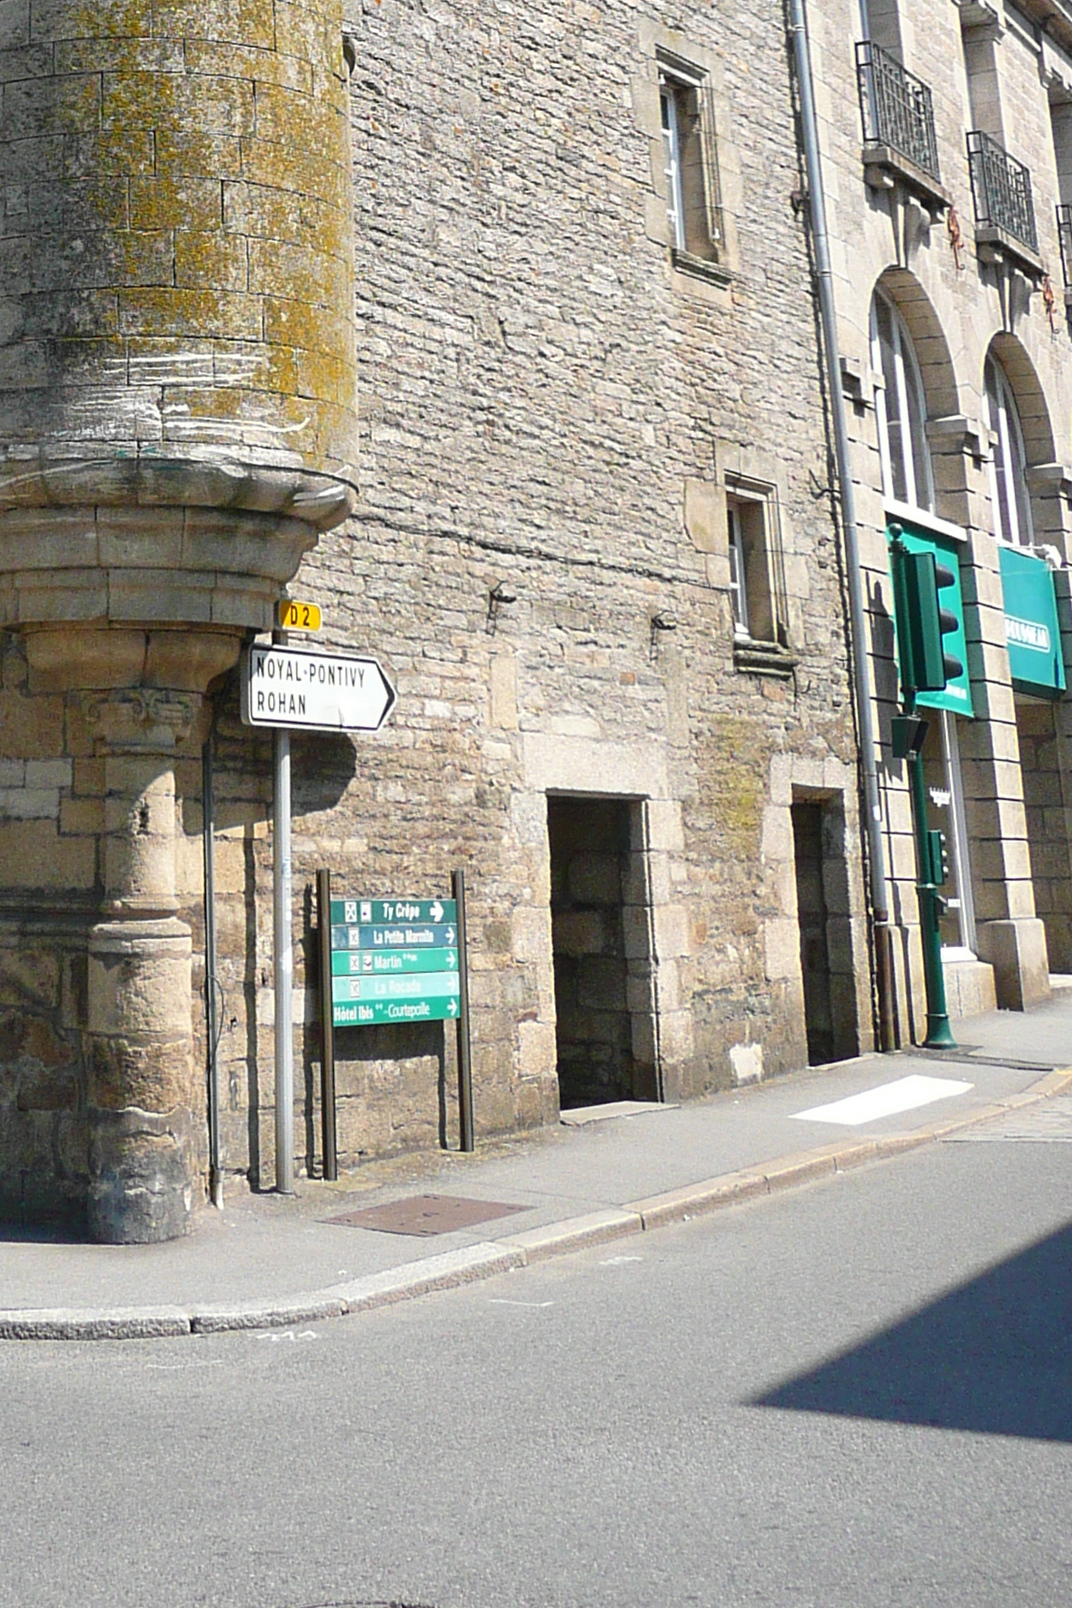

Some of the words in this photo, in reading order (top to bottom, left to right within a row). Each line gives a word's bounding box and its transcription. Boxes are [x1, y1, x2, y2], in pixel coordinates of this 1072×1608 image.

[290, 605, 298, 625] D
[303, 607, 310, 626] 2
[256, 656, 365, 688] NOYAL-PONTIVY
[257, 690, 306, 715] ROHAN
[383, 903, 394, 921] Ty
[373, 930, 383, 944] La
[374, 954, 403, 969] Martin
[333, 1005, 357, 1022] Hôtel
